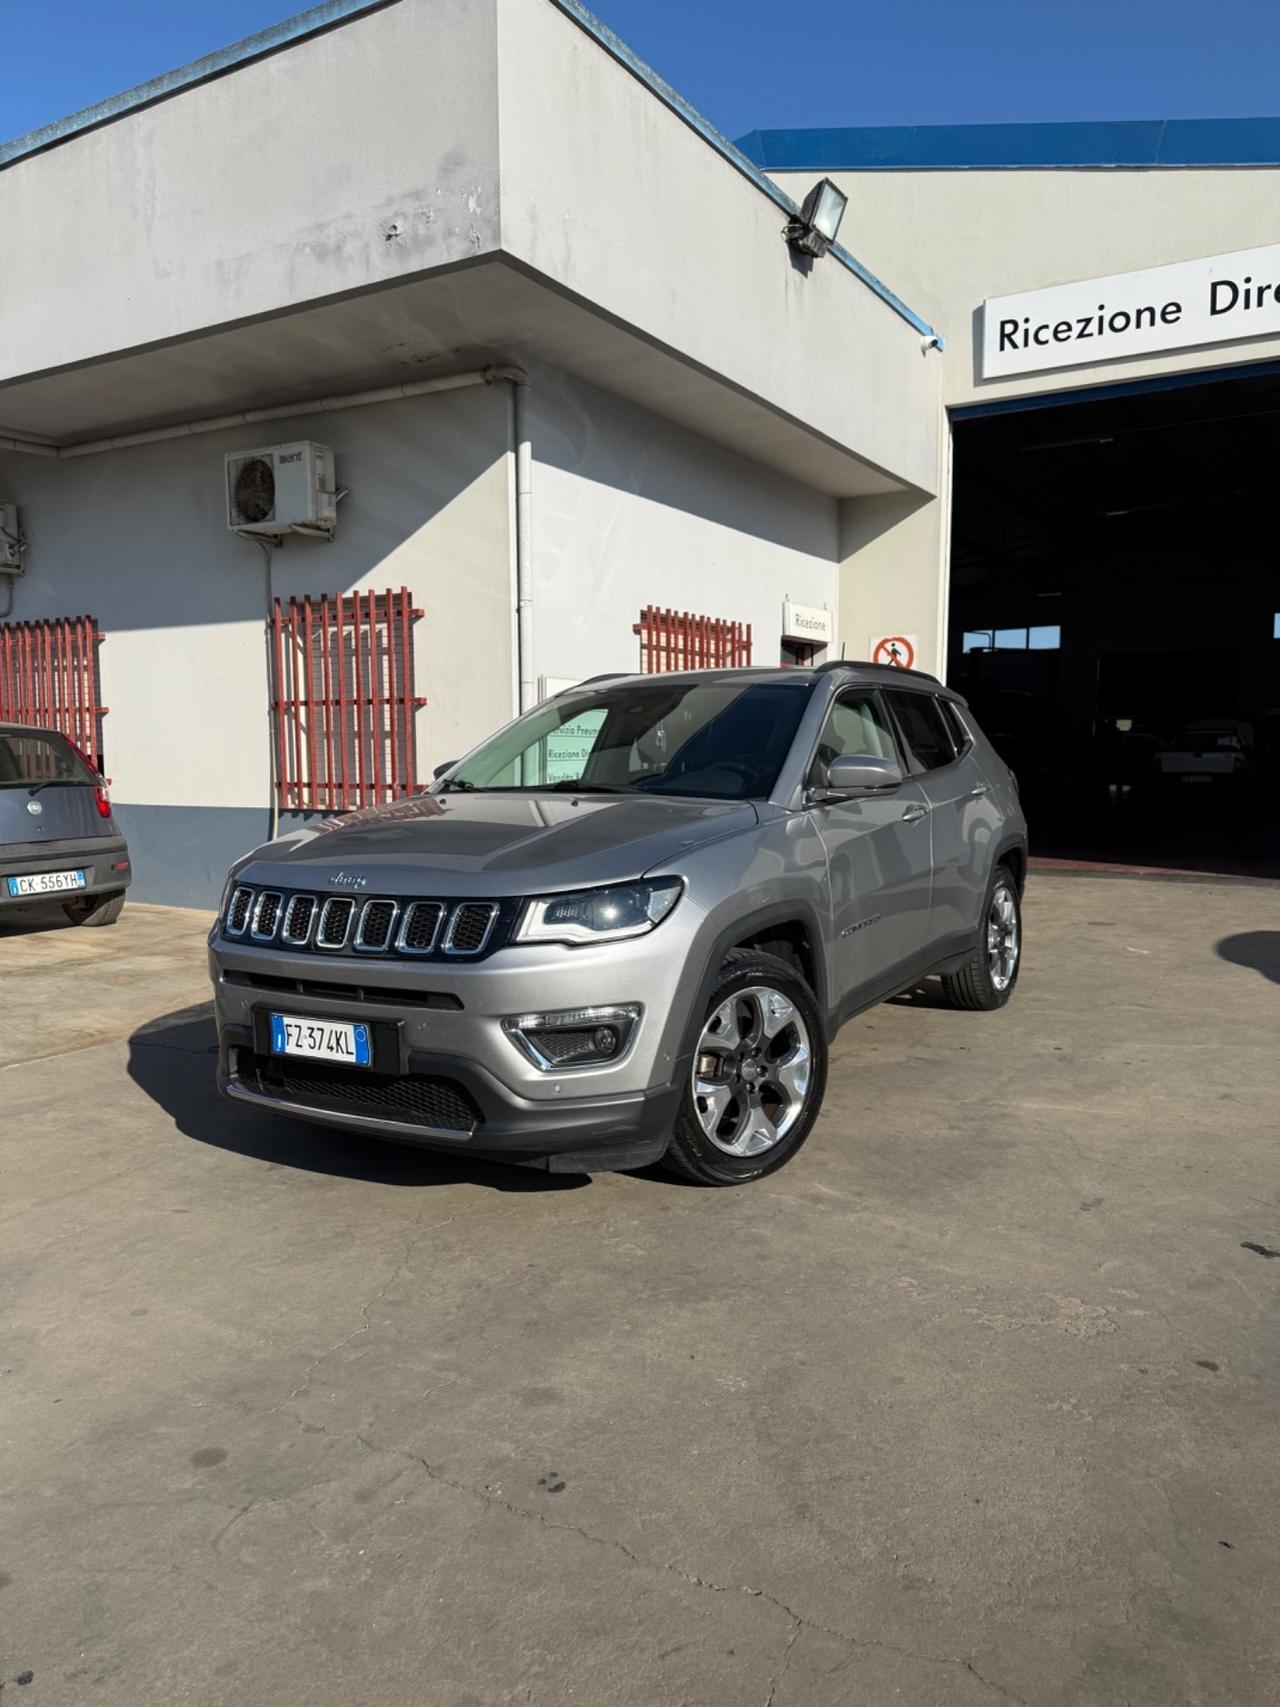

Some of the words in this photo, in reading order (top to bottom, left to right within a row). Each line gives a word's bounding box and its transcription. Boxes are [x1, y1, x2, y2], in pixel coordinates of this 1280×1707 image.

[999, 301, 1183, 352] Ricezione
[795, 613, 826, 632] Ricezione
[549, 748, 580, 758] Ricezione
